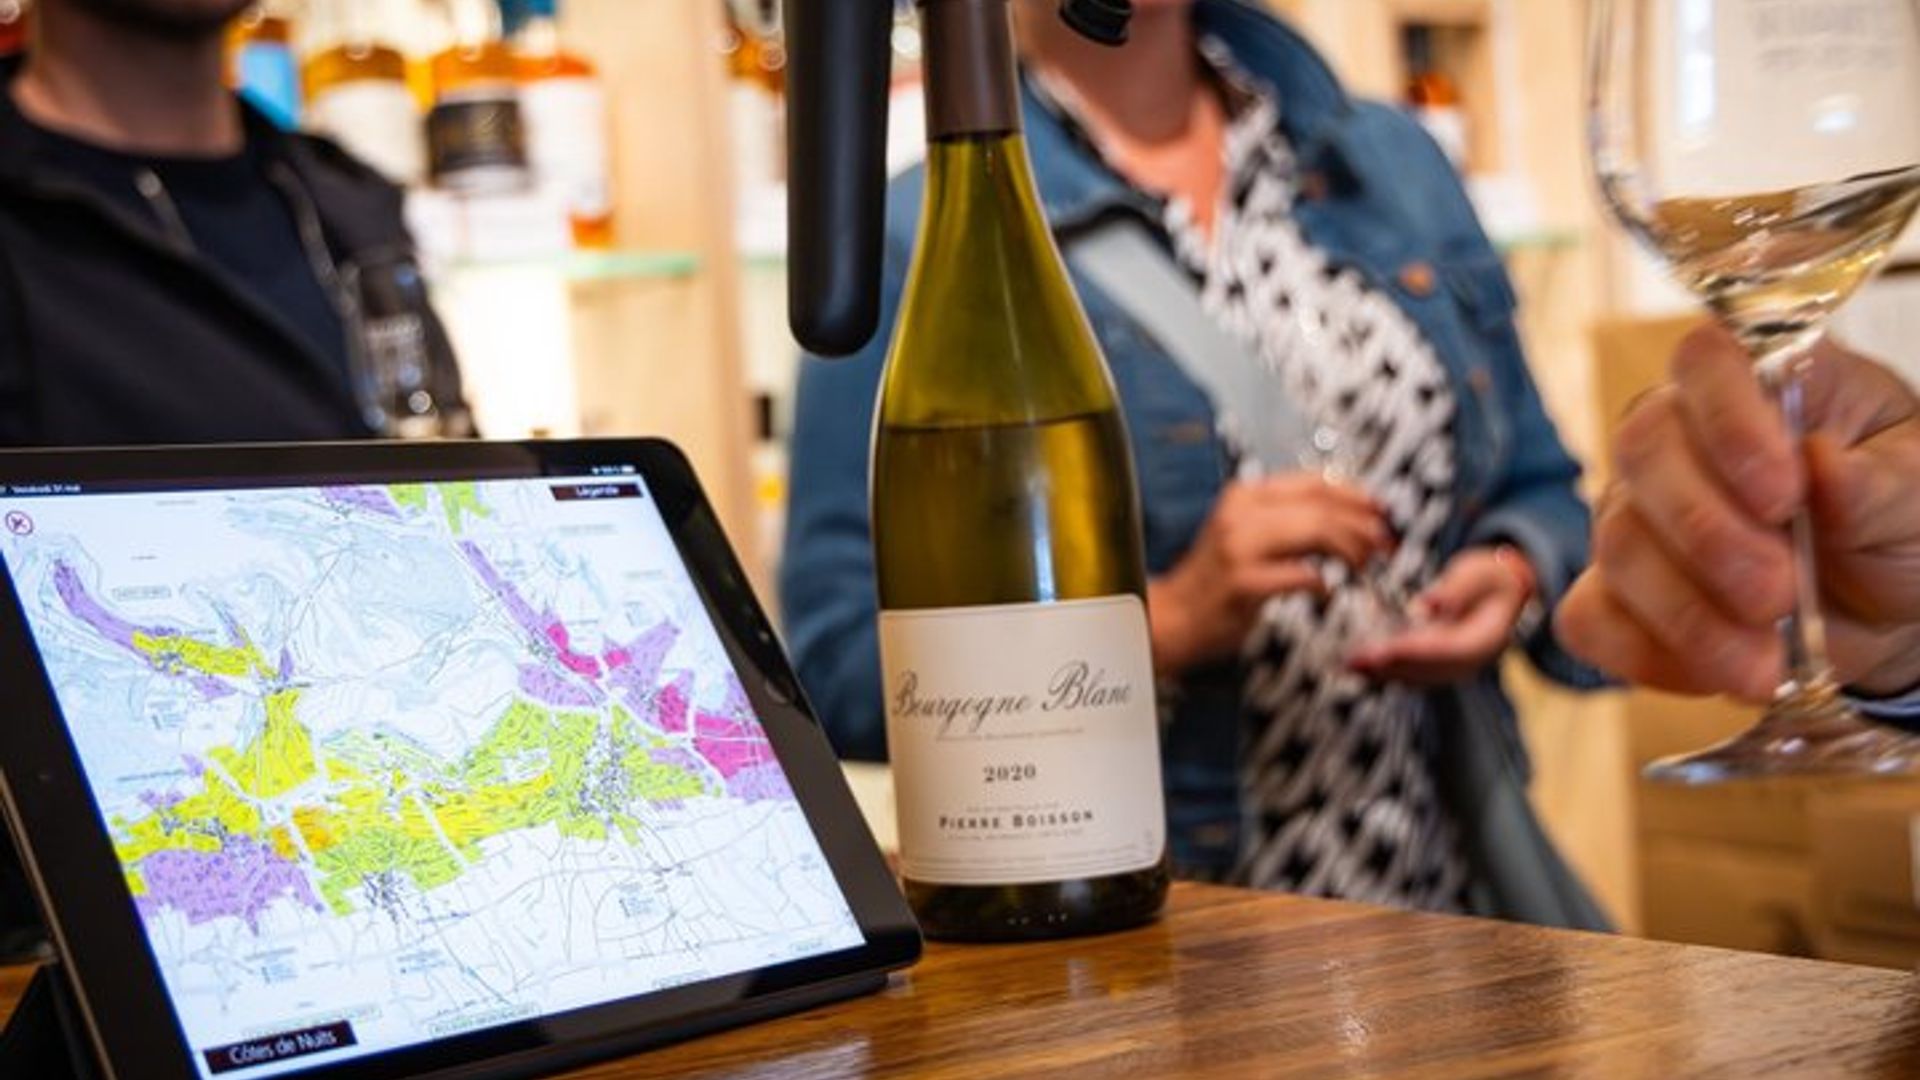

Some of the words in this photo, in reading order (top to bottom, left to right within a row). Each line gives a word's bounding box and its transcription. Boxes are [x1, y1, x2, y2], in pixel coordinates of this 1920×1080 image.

[892, 669, 1029, 735] Bourgogne
[1042, 660, 1131, 712] Blanc
[983, 763, 1037, 783] 2020
[1012, 810, 1094, 829] BOISSON
[229, 1043, 275, 1064] Côtes
[275, 1036, 297, 1055] de
[296, 1030, 337, 1050] Nuits
